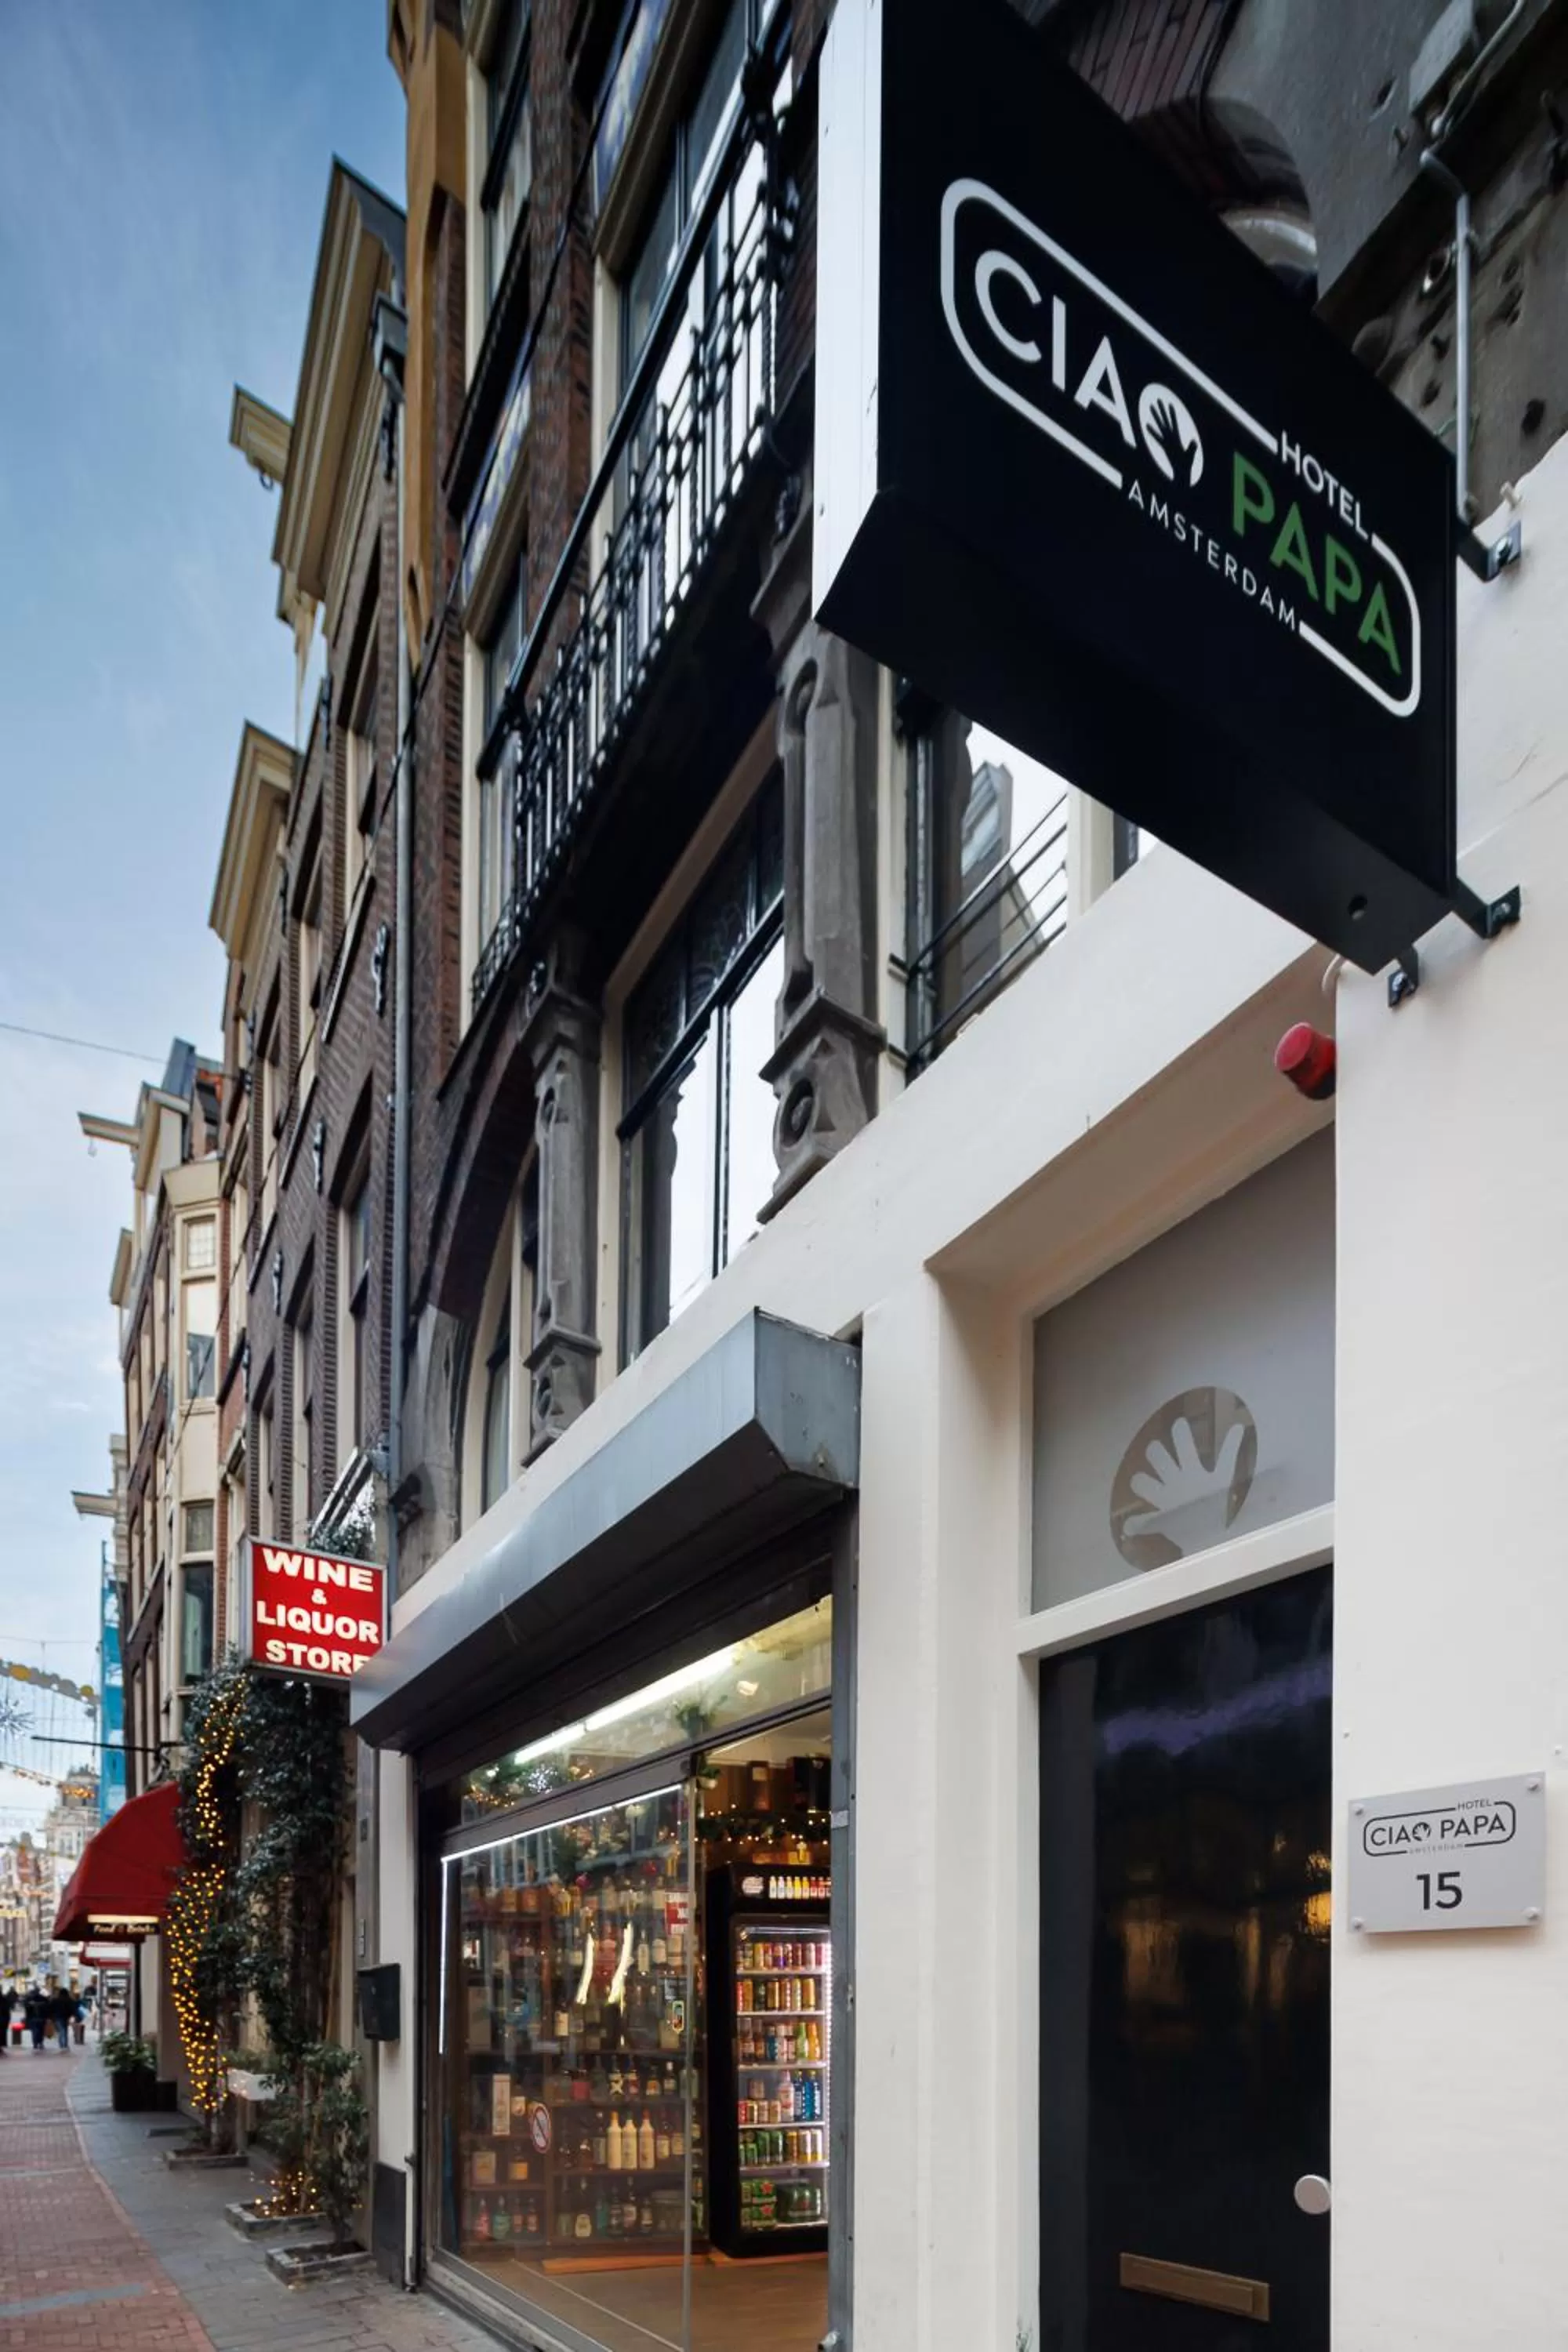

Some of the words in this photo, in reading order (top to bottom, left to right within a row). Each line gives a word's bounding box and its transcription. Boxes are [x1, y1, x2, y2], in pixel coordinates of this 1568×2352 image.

[1282, 430, 1369, 541] HOTEL
[1127, 478, 1296, 631] AMSTERDAM
[1232, 451, 1402, 676] PAPA
[262, 1548, 374, 1592] WINE
[311, 1588, 328, 1605] &
[256, 1599, 380, 1644] LIQUOR
[1440, 1812, 1506, 1839] PAPA
[1457, 1798, 1492, 1810] HOTEL
[1416, 1871, 1462, 1910] 15
